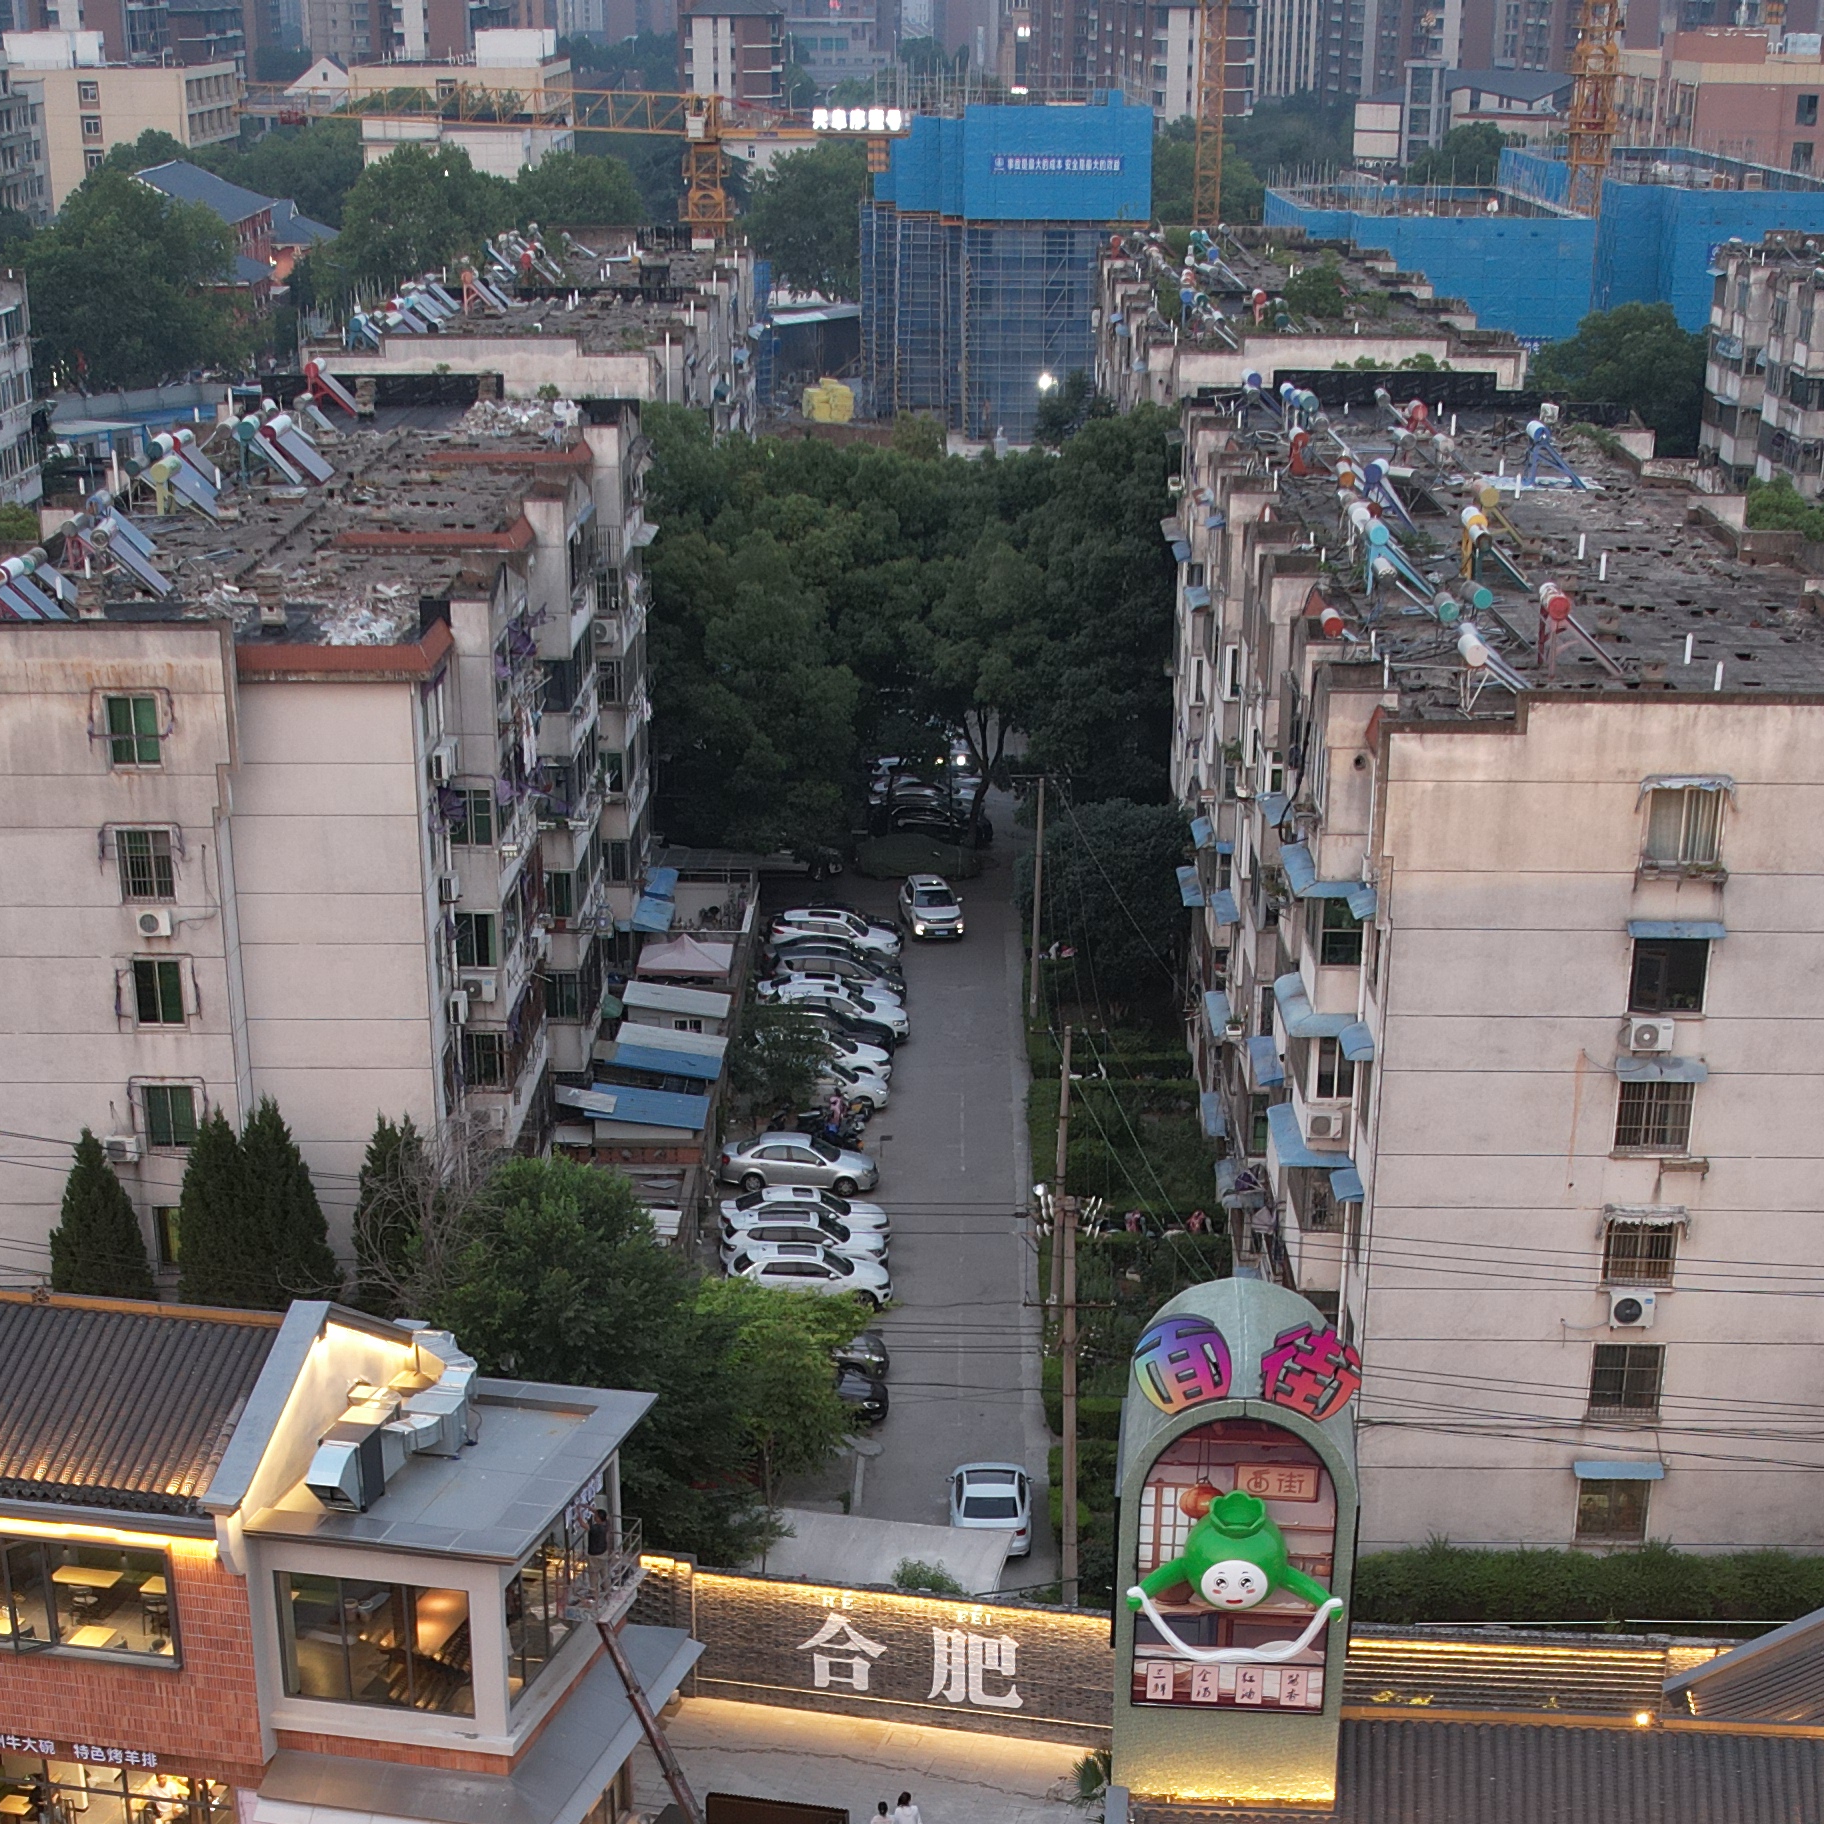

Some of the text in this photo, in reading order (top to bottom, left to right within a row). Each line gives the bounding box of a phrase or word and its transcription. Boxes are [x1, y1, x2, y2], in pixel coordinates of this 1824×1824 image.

[1133, 1314, 1363, 1422] 面街
[796, 1612, 1024, 1709] 合肥
[73, 1743, 159, 1769] 特色烤羊排
